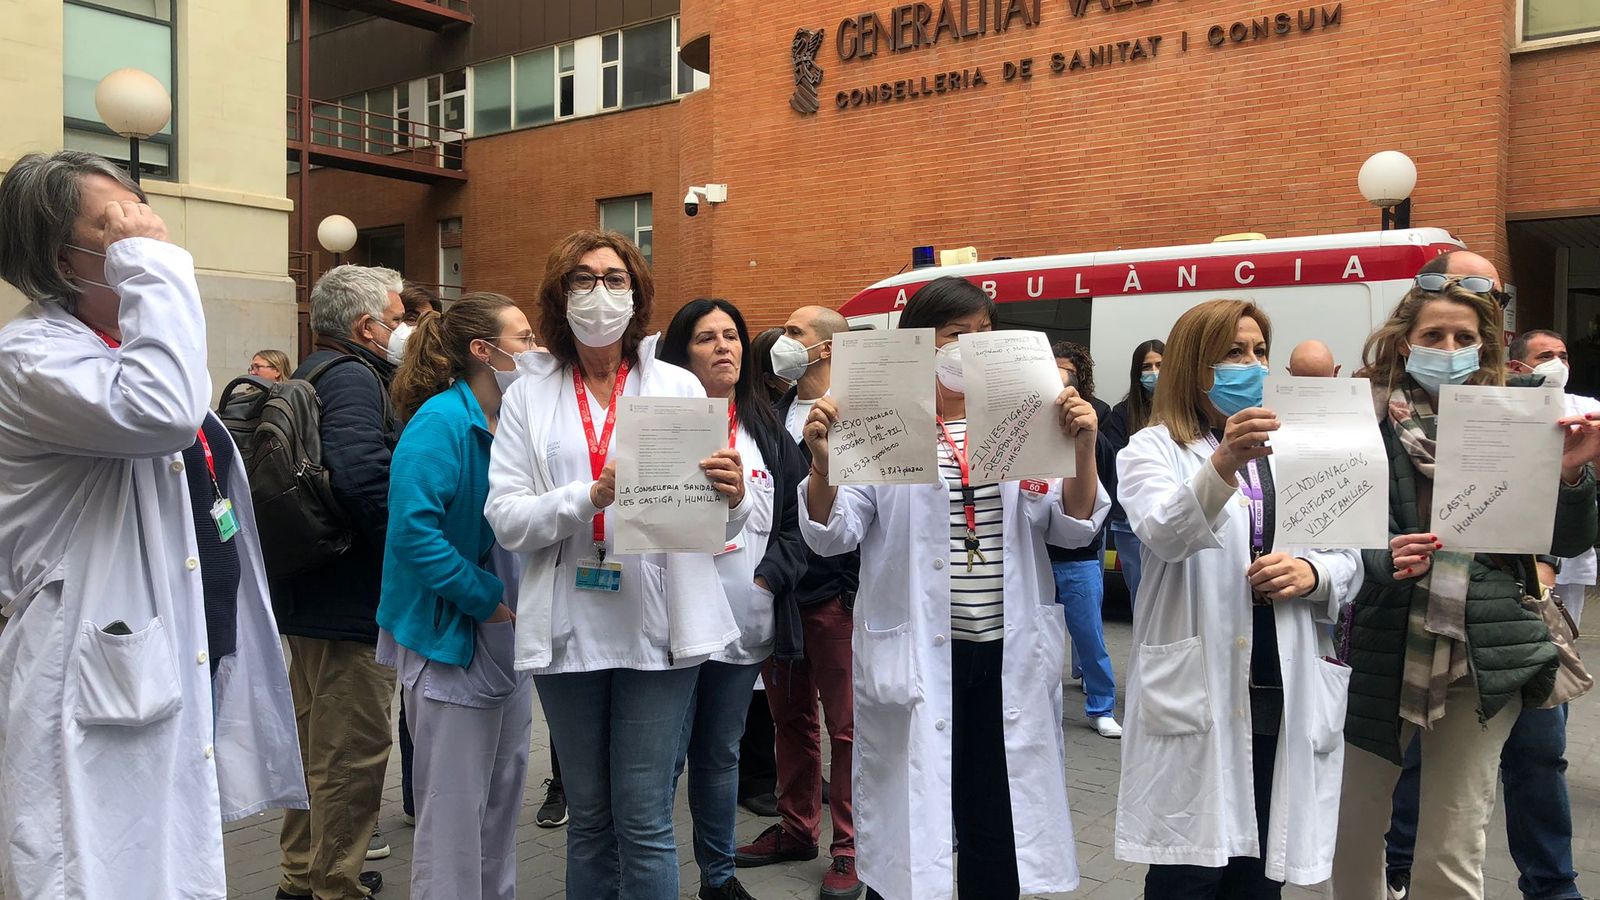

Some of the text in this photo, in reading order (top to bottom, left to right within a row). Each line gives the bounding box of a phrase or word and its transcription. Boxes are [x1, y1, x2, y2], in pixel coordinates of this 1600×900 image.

[835, 2, 1342, 109] CONSELLERIA DE SANITAT I CONSUM
[893, 254, 1366, 309] ABULÀNCIA
[866, 409, 894, 422] BACALAO
[833, 418, 862, 433] SEXO
[842, 430, 856, 441] CON
[834, 437, 865, 456] DROGAS
[620, 486, 630, 494] LA
[634, 484, 678, 494] CONSELLERIA
[1030, 484, 1040, 492] 60
[619, 498, 634, 506] LES
[639, 495, 673, 505] CASTIGA
[685, 493, 720, 504] HUMILLA
[1282, 477, 1350, 532] SACRIFICADO LA
[1305, 480, 1369, 535] VIDA FAMILIAR
[1439, 484, 1476, 521] CASTIGO
[1452, 480, 1508, 534] HUMILLACIÓN
